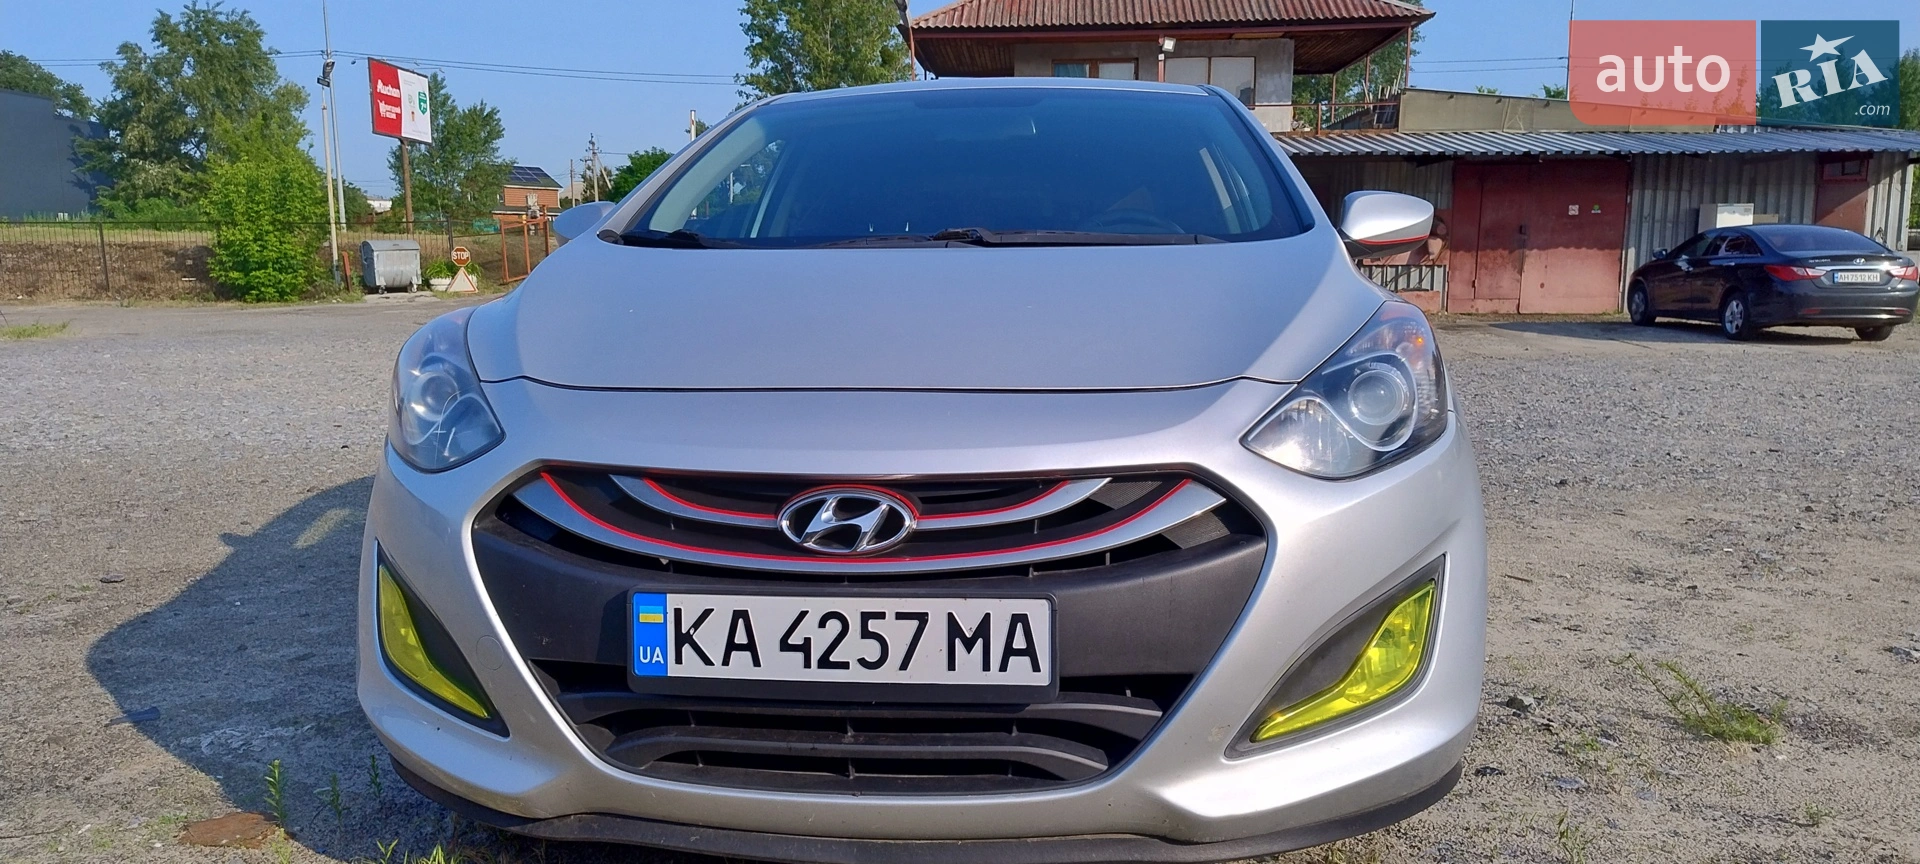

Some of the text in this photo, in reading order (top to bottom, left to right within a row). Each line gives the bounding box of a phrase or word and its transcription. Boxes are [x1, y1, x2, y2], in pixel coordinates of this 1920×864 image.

[377, 79, 400, 98] Auchan
[452, 251, 469, 260] STOP
[673, 607, 1042, 673] KA 4257 MA
[639, 646, 664, 664] UA
